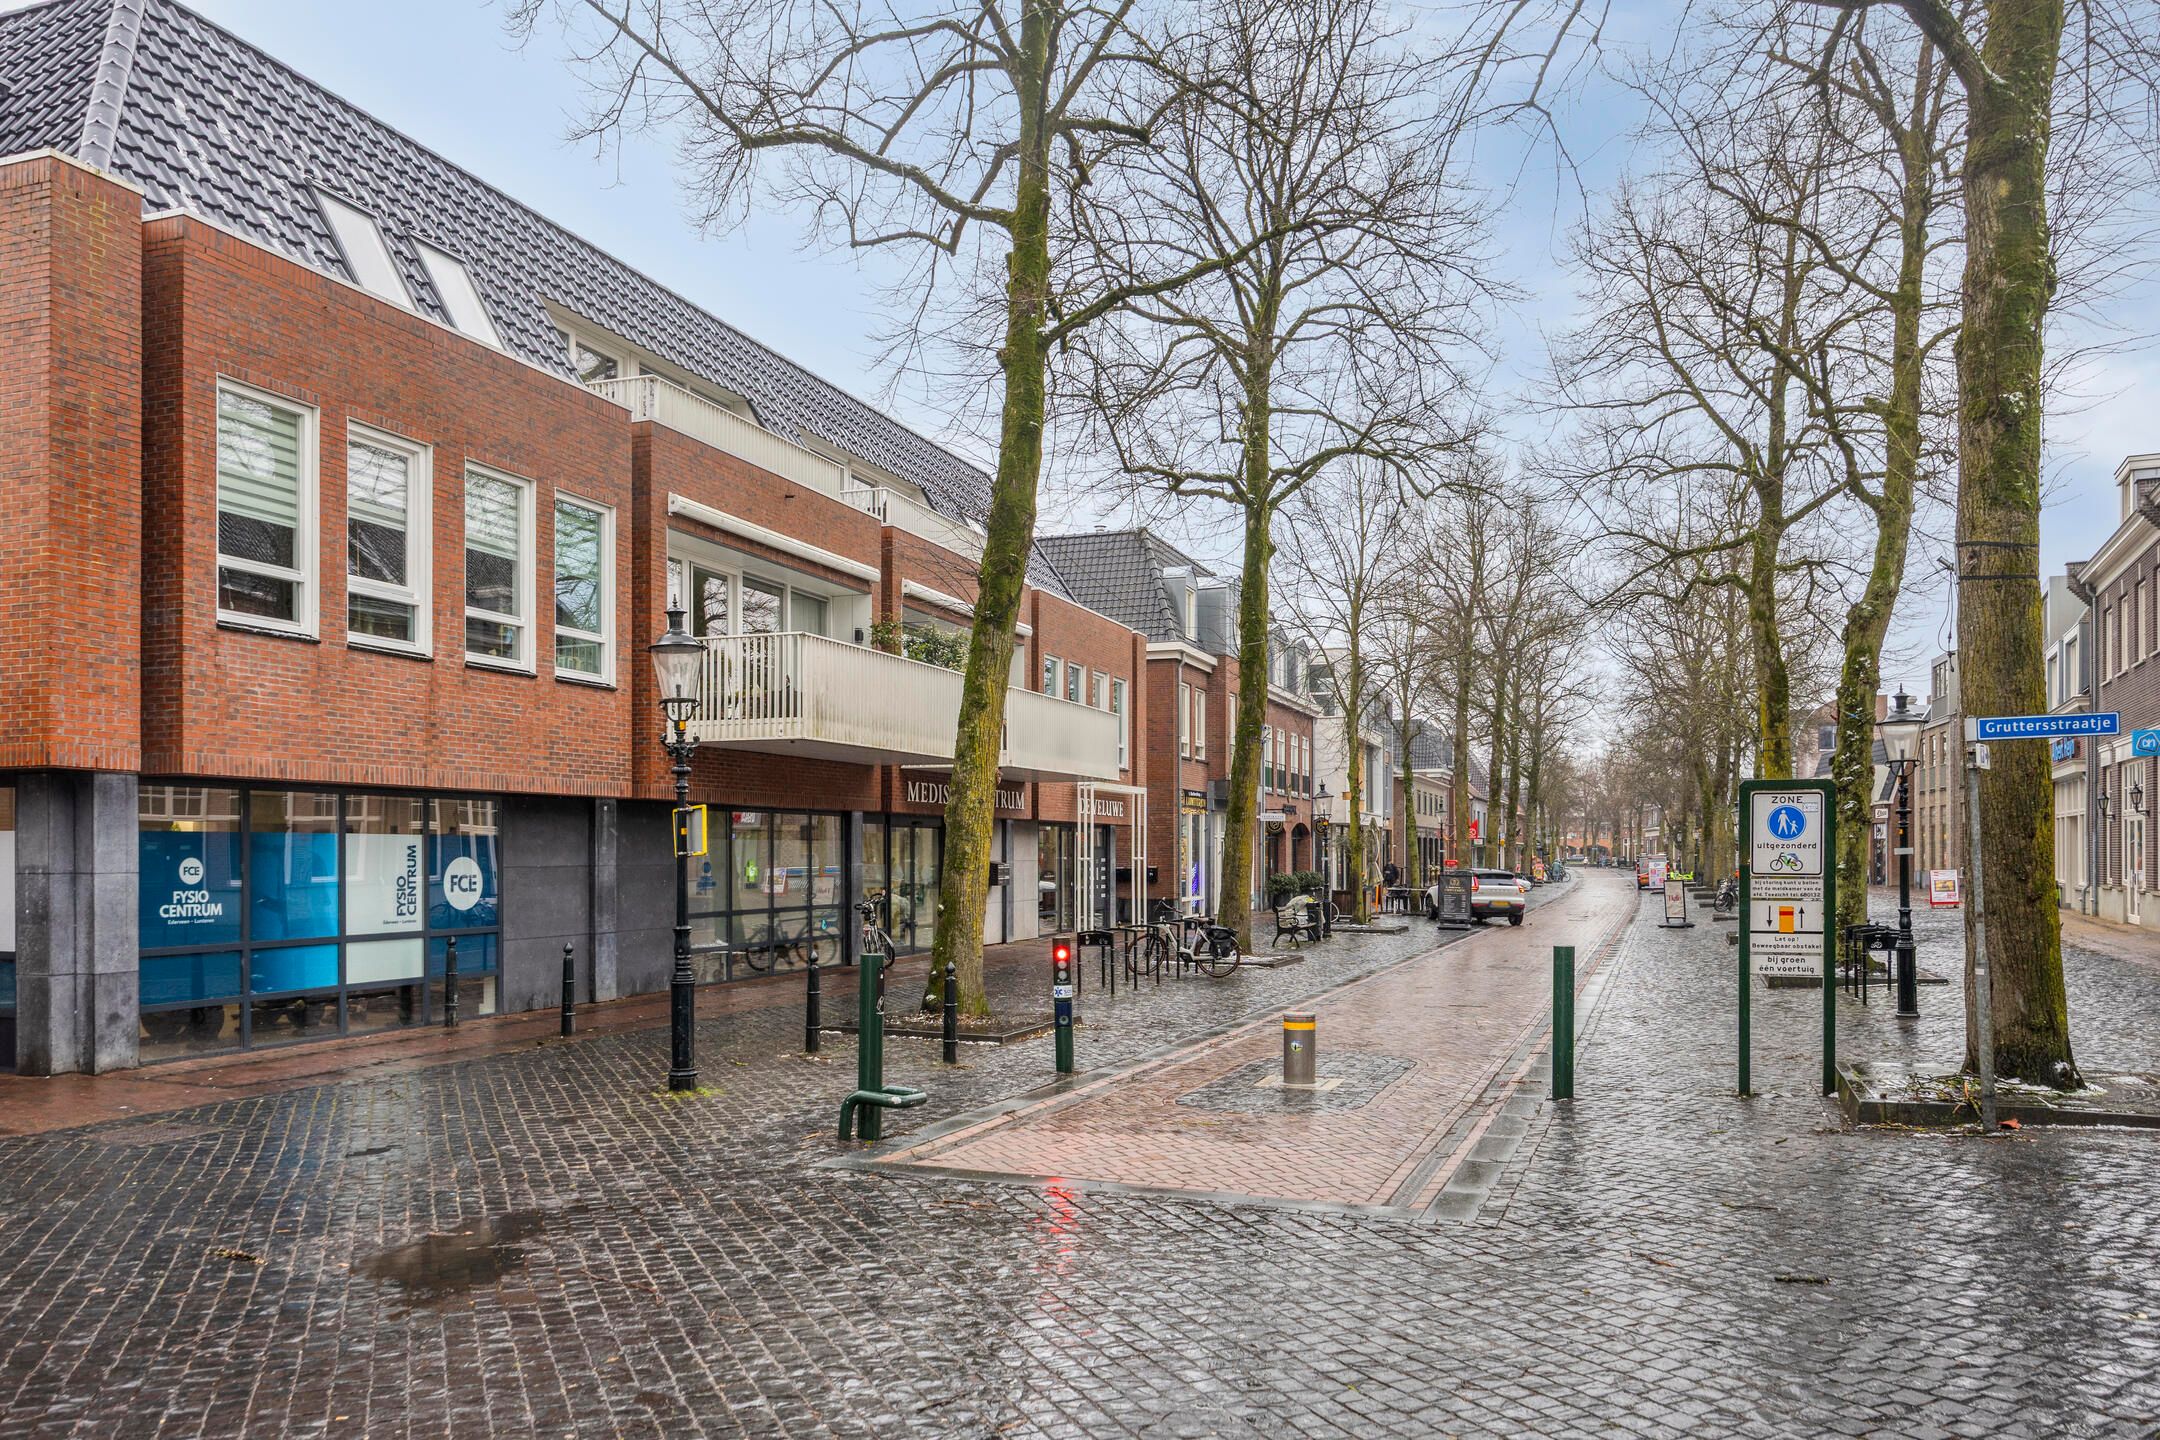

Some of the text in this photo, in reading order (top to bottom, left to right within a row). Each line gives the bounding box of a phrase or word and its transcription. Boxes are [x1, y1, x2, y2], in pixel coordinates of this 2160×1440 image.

[1985, 717, 2111, 733] Gruttersstraatje
[907, 781, 950, 804] MEDIS
[1771, 796, 1803, 804] ZONE
[183, 866, 200, 876] FCE
[407, 845, 417, 916] CENTRUM
[450, 874, 477, 893] FCE
[172, 890, 209, 904] FYSIO
[396, 875, 406, 916] FYSIO
[159, 903, 223, 918] CENTRUM
[1767, 956, 1778, 964] bij
[1776, 966, 1815, 974] voertuig
